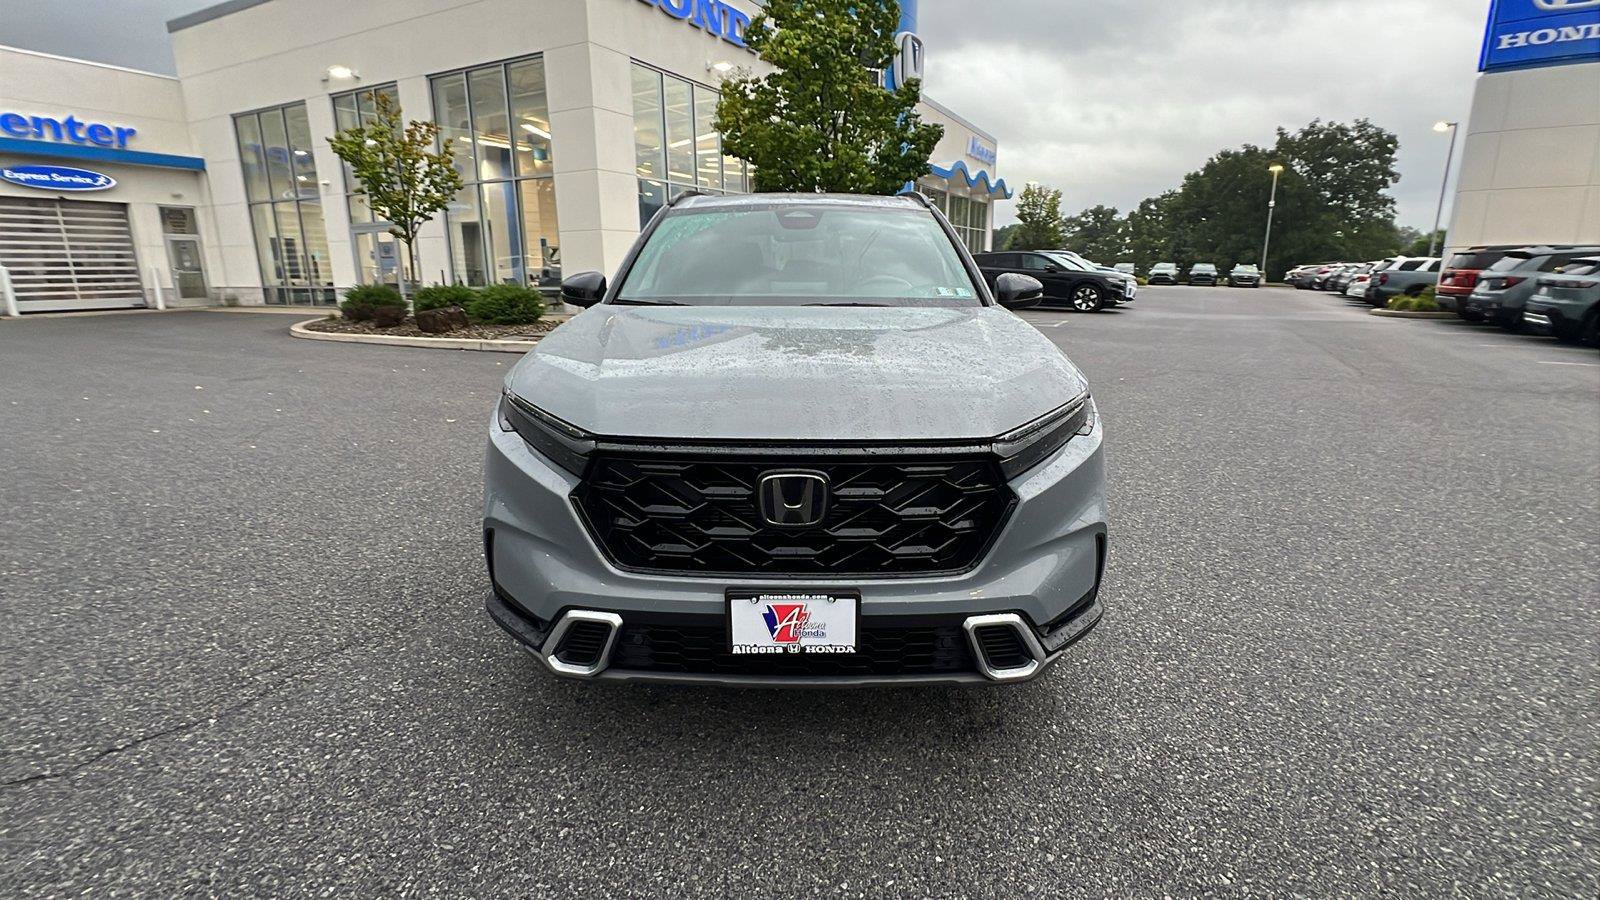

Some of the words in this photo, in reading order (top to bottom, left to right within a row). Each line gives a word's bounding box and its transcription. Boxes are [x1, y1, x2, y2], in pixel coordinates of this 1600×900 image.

[0, 112, 137, 148] enter
[3, 168, 50, 182] Express
[50, 172, 93, 185] Service
[794, 629, 826, 638] Honda
[732, 644, 784, 654] Altoona
[805, 645, 856, 654] HONDA
